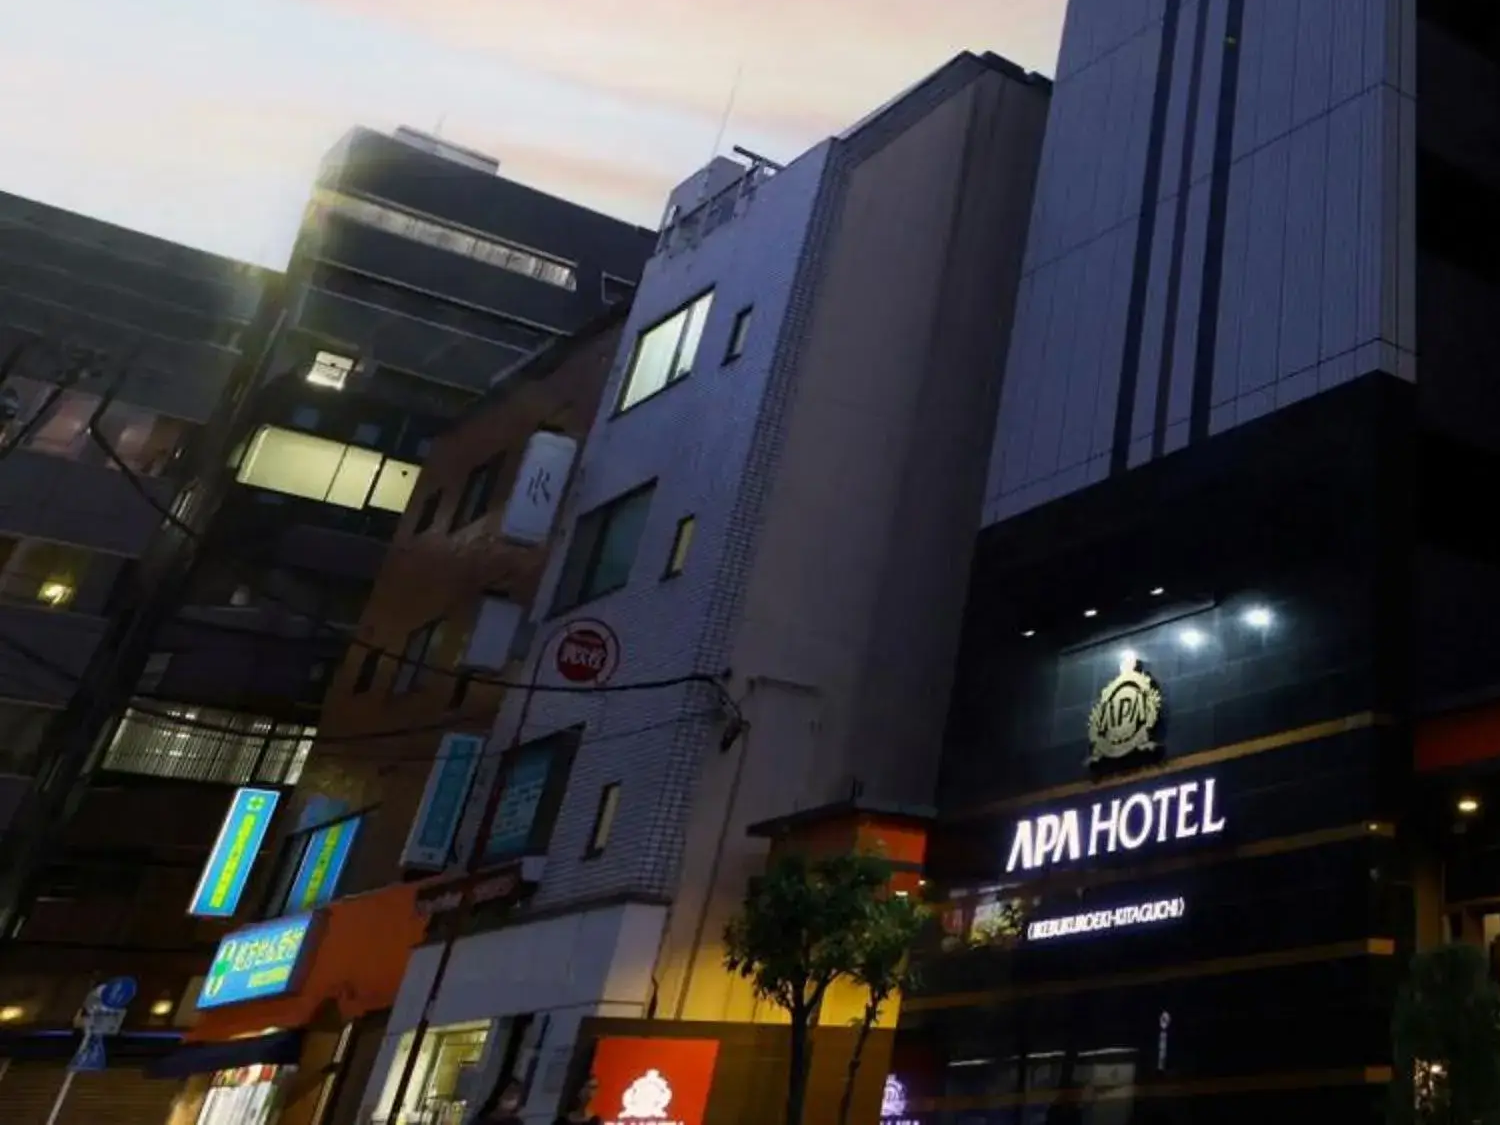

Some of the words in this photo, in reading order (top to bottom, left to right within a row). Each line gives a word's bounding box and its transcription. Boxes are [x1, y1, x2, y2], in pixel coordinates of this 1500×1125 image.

[1097, 691, 1148, 737] APA
[1005, 809, 1081, 873] APA
[1088, 777, 1227, 857] HOTEL
